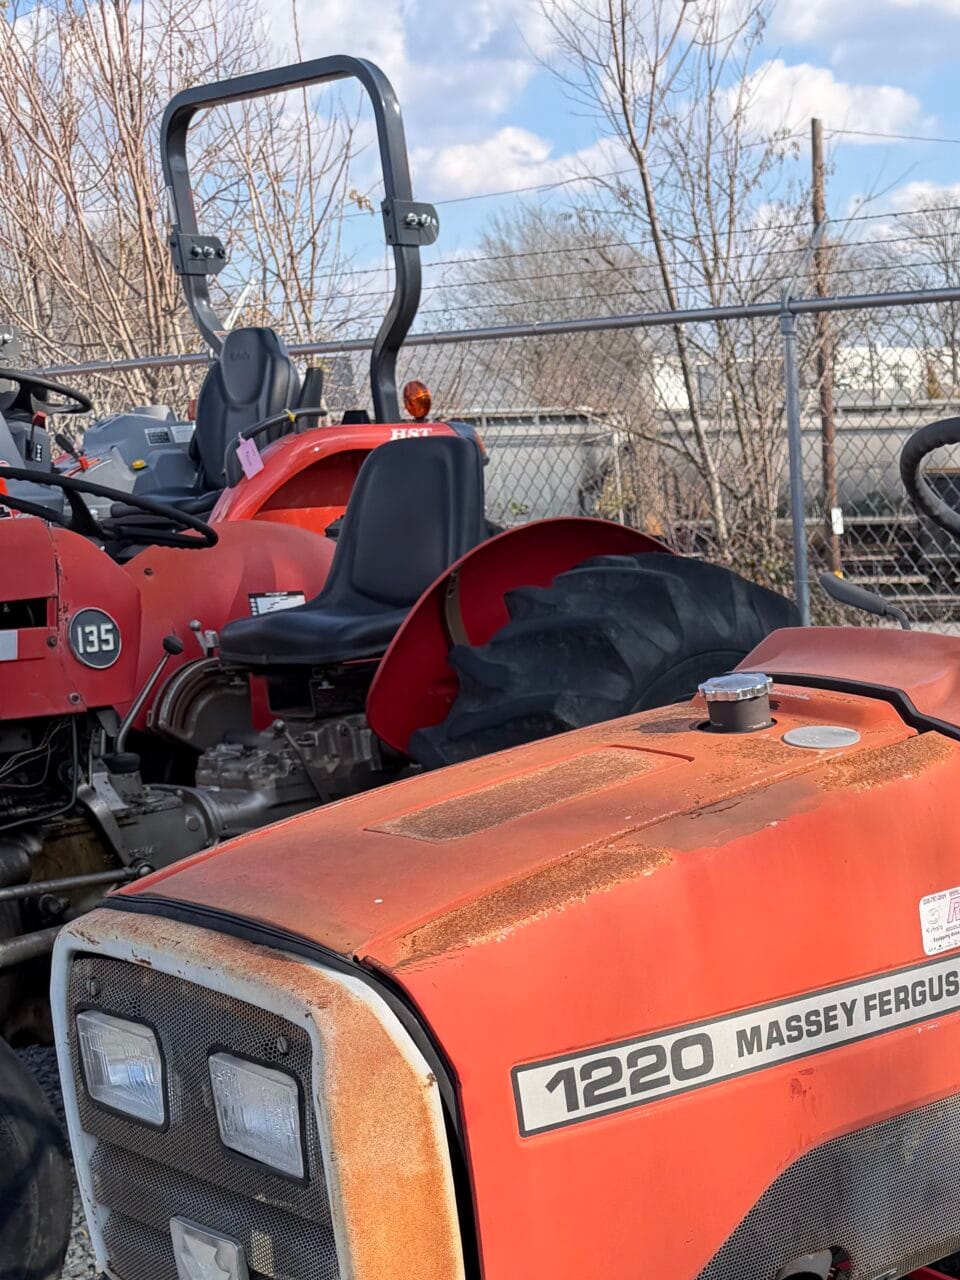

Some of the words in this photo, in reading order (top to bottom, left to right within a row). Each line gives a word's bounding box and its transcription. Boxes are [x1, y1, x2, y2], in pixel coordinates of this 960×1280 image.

[390, 427, 432, 441] HST
[77, 623, 115, 654] 135
[545, 1032, 714, 1113] 1220
[735, 998, 858, 1058] MASSEY
